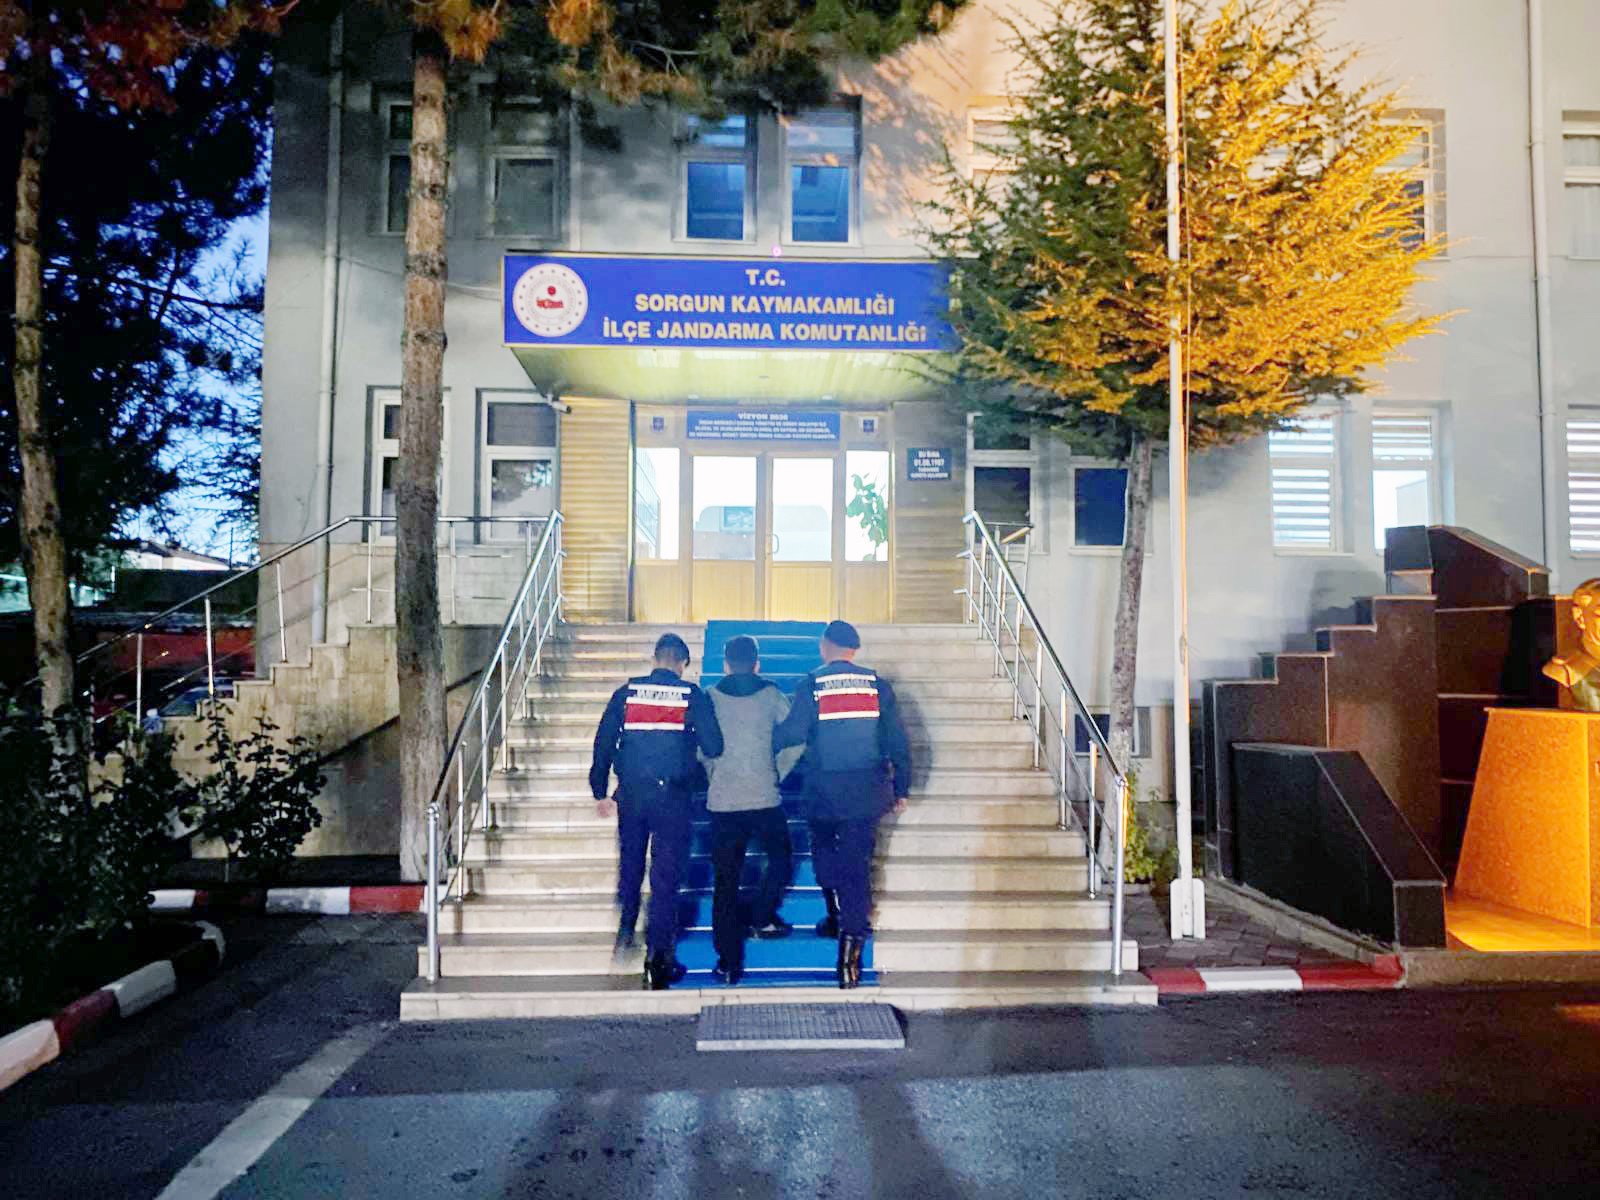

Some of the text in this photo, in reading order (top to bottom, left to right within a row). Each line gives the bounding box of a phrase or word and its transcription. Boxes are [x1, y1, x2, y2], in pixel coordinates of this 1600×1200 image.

[745, 268, 786, 286] T.C.
[635, 292, 895, 315] SORGUN KAYMAKAMLIĞI
[603, 317, 926, 342] İLÇE JANDARMA KOMUTANLIĞI
